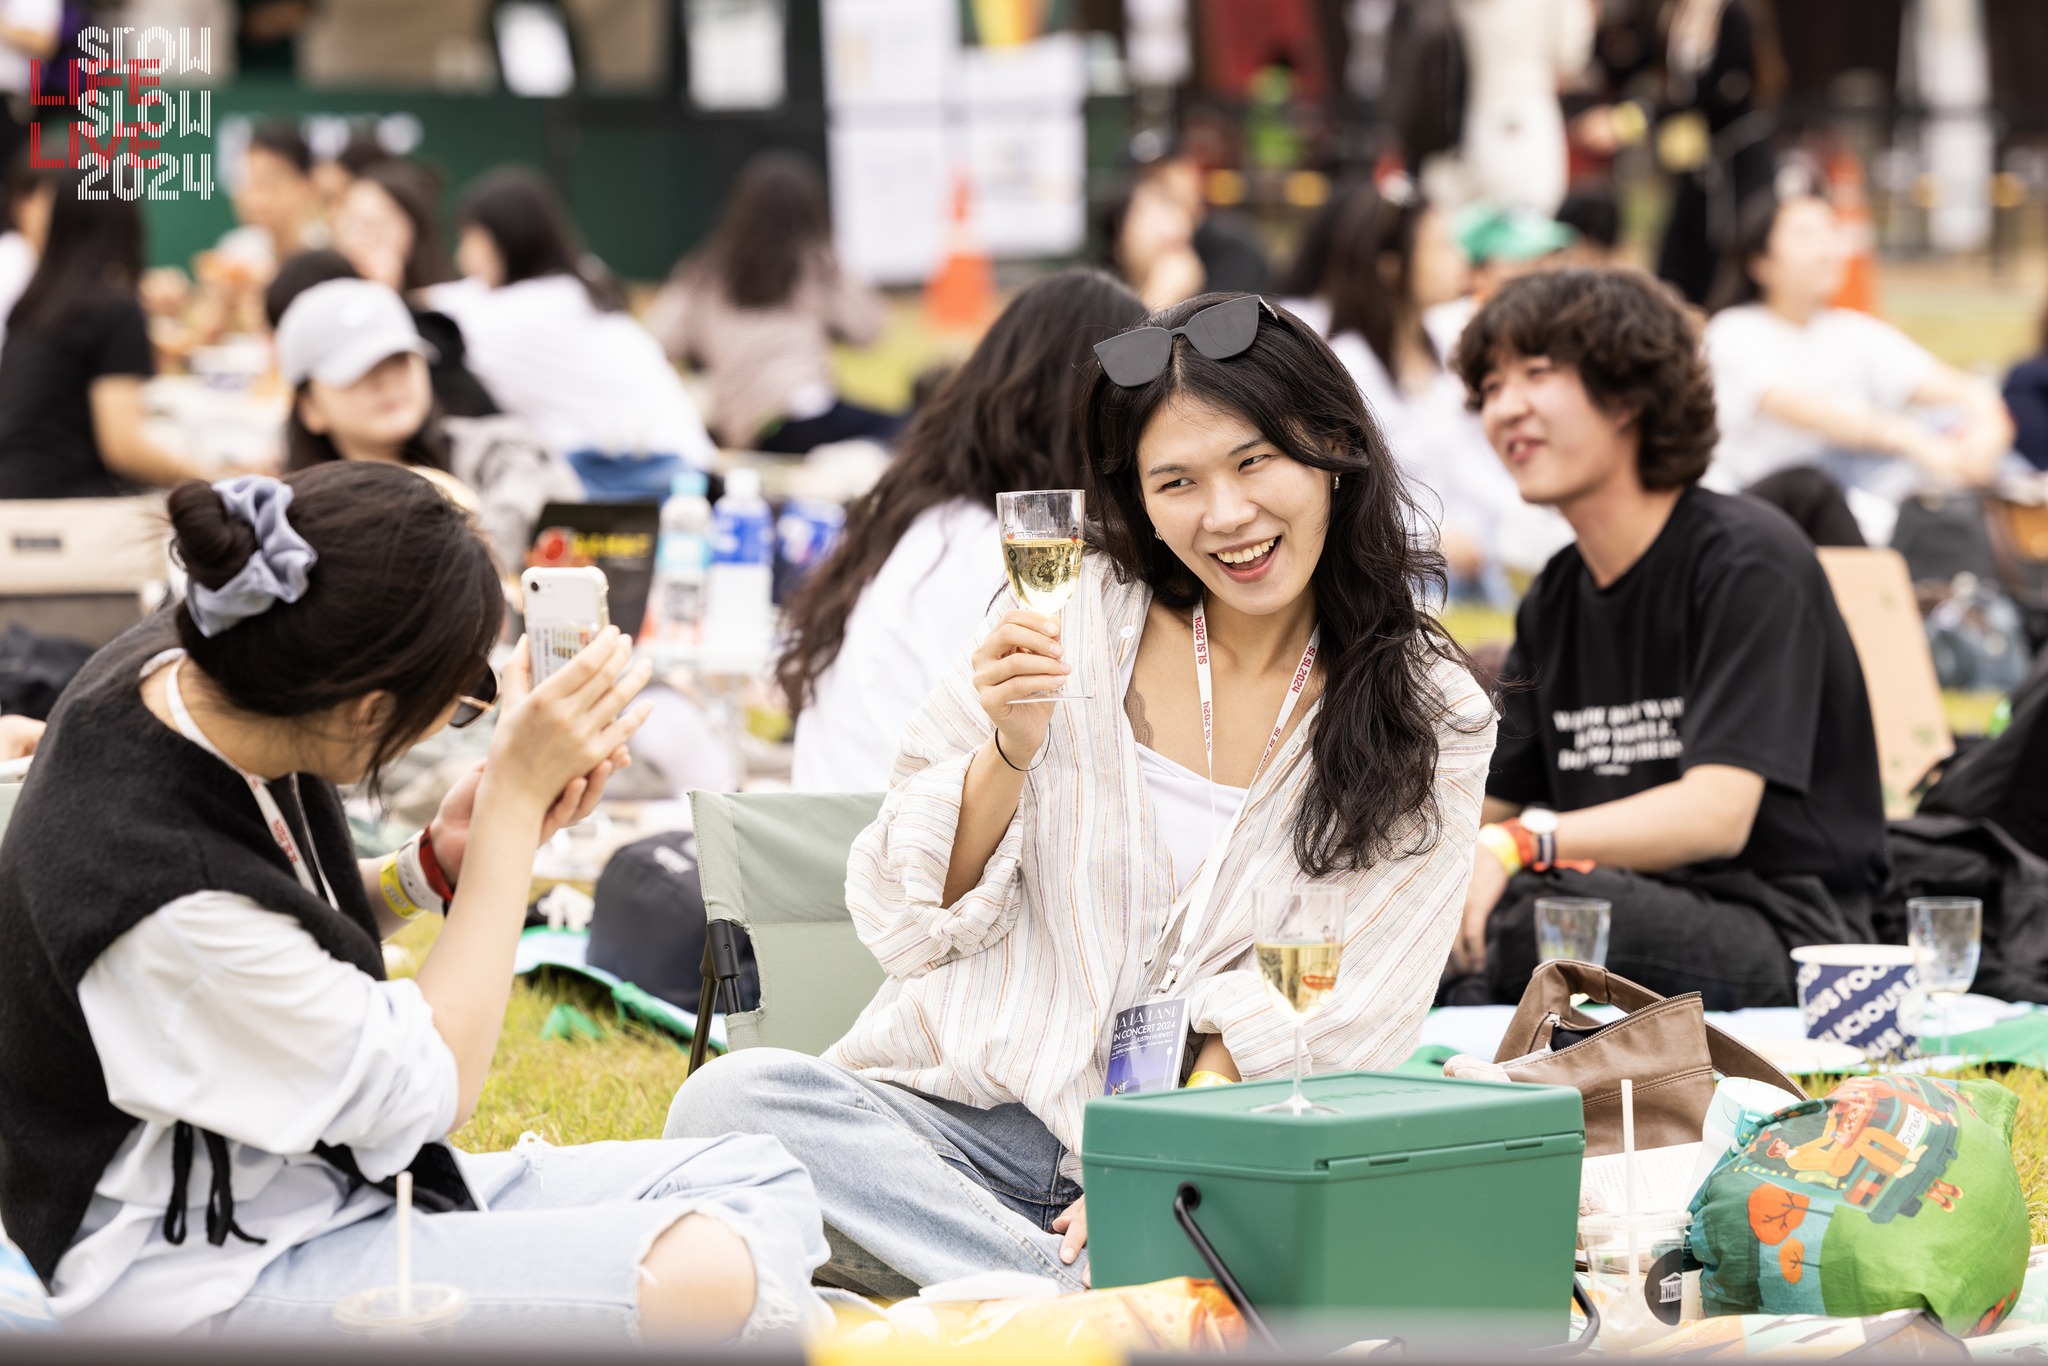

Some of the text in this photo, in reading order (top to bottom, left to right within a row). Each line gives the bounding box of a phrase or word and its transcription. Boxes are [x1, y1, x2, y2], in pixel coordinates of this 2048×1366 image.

[1195, 616, 1208, 665] SLSL2024
[1291, 645, 1316, 693] SLSL2024
[1121, 1023, 1156, 1039] CONCERT
[1157, 1020, 1176, 1031] 2024
[1129, 1011, 1144, 1026] LA
[1148, 1006, 1178, 1021] LAND
